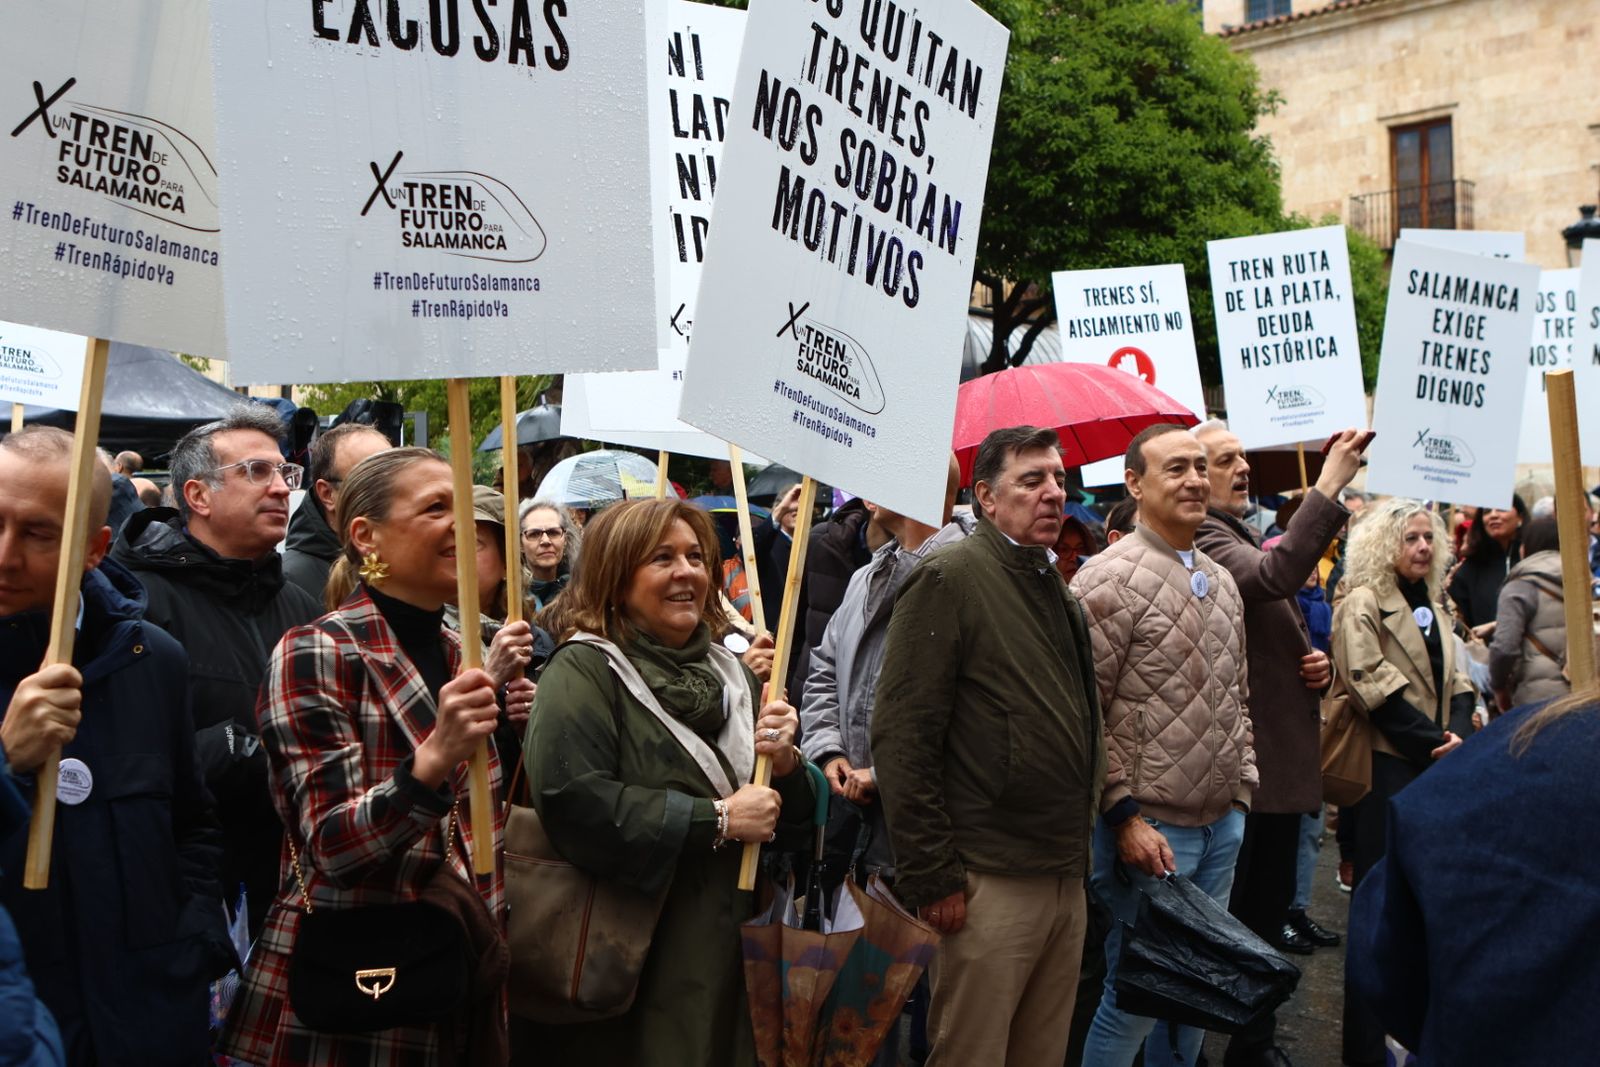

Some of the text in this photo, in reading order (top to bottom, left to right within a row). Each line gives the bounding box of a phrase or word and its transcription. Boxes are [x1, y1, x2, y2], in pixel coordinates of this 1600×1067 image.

[860, 0, 983, 120] QUITAN
[807, 20, 935, 175] TRENES,
[52, 114, 73, 131] UN
[69, 112, 154, 161] TREN
[152, 151, 168, 166] DE
[58, 140, 185, 194] FUTURO PARA
[752, 68, 962, 256] NOS SOBRAN
[57, 165, 186, 214] SALAMANCA
[390, 188, 407, 200] UN
[403, 181, 473, 211] TREN
[472, 200, 486, 212] DE
[12, 200, 219, 266] #TrenDeFuturoSalamanca
[400, 209, 504, 233] FUTURO PARA
[771, 164, 924, 309] MOTIVOS
[401, 231, 508, 250] SALAMANCA
[54, 241, 175, 286] #TrenRápidoYa
[373, 271, 541, 291] #TrenDeFuturoSalamanca
[1228, 249, 1330, 282] TREN RUTA
[1083, 280, 1160, 307] TRENES SÍ,
[1225, 278, 1340, 312] DE LA PLATA,
[1407, 269, 1519, 313] SALAMANCA
[412, 299, 509, 320] #TrenRápidoYa
[1069, 311, 1183, 339] AISLAMIENTO NO
[1257, 310, 1314, 338] DEUDA
[1433, 308, 1486, 341] EXIGE
[1, 346, 31, 358] TREN
[798, 342, 849, 379] FUTURO
[805, 324, 846, 362] TREN
[1240, 336, 1338, 369] HISTÓRICA
[1421, 340, 1491, 375] TRENES
[796, 359, 860, 400] SALAMANCA
[1416, 374, 1486, 409] DIGNOS
[773, 379, 876, 438] #TrenDeFuturoSalamanca
[792, 409, 853, 448] #TrenRápidoYa
